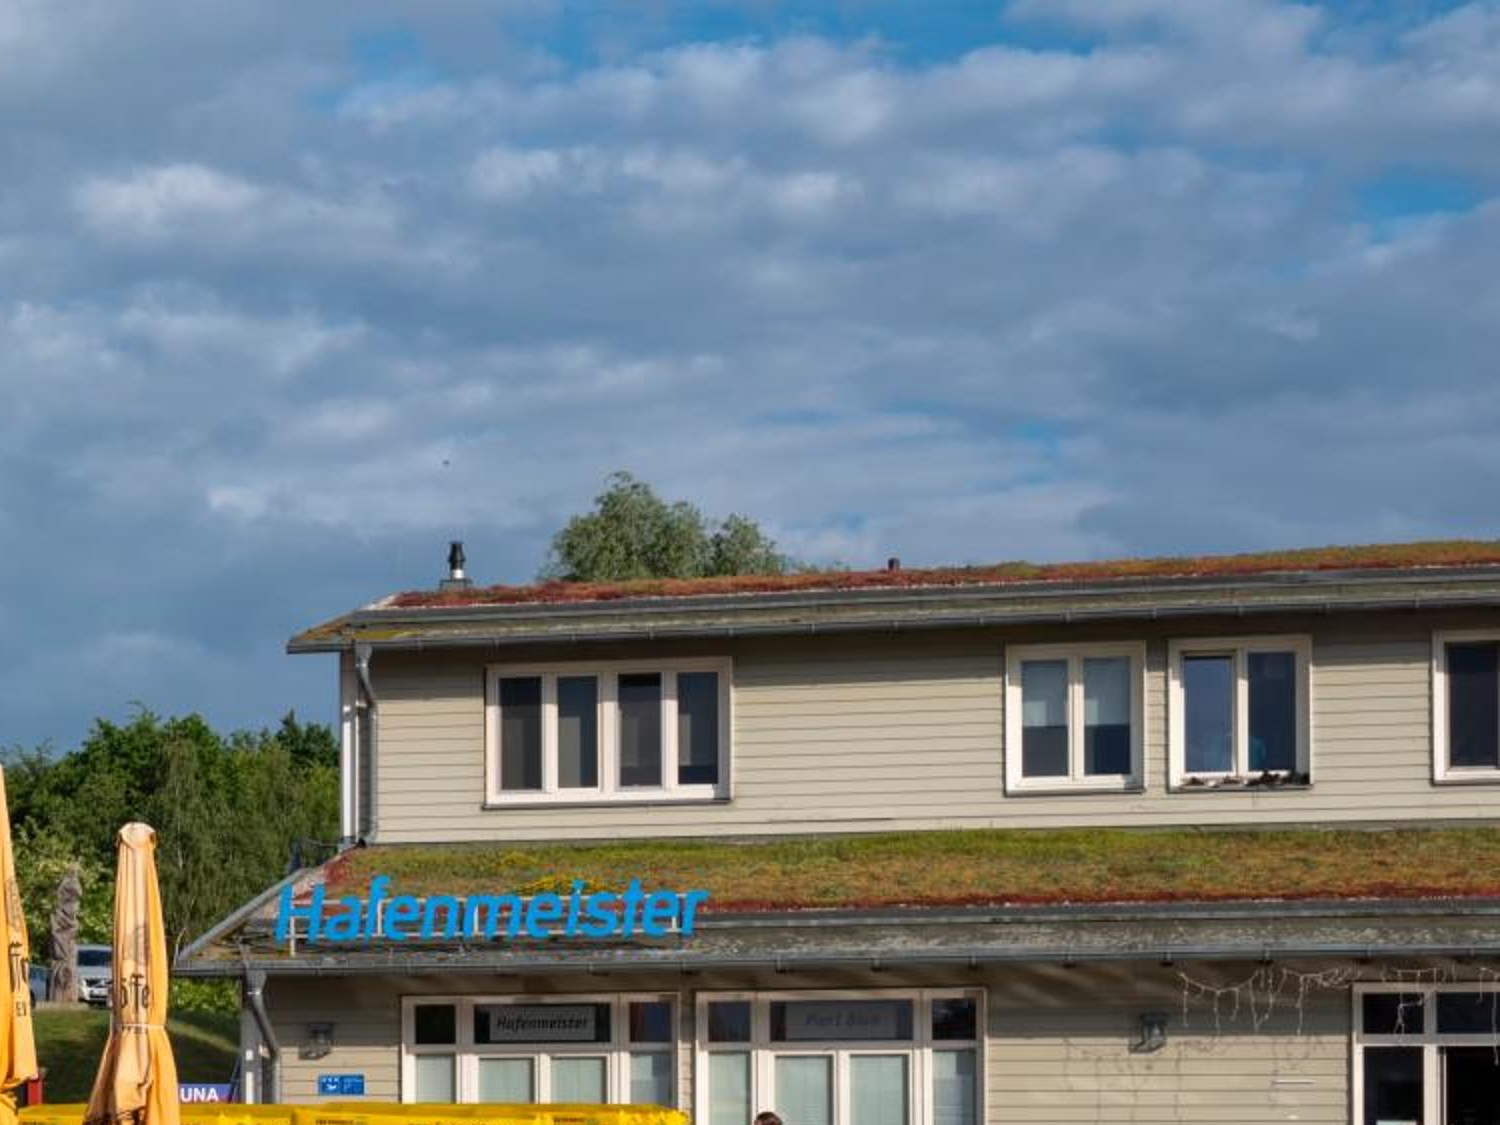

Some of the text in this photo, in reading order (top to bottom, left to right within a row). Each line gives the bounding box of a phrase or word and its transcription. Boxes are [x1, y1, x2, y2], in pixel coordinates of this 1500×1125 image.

[274, 875, 708, 948] Hafenmeister
[497, 1015, 587, 1033] Hafenmeister
[180, 1087, 219, 1102] UNA
